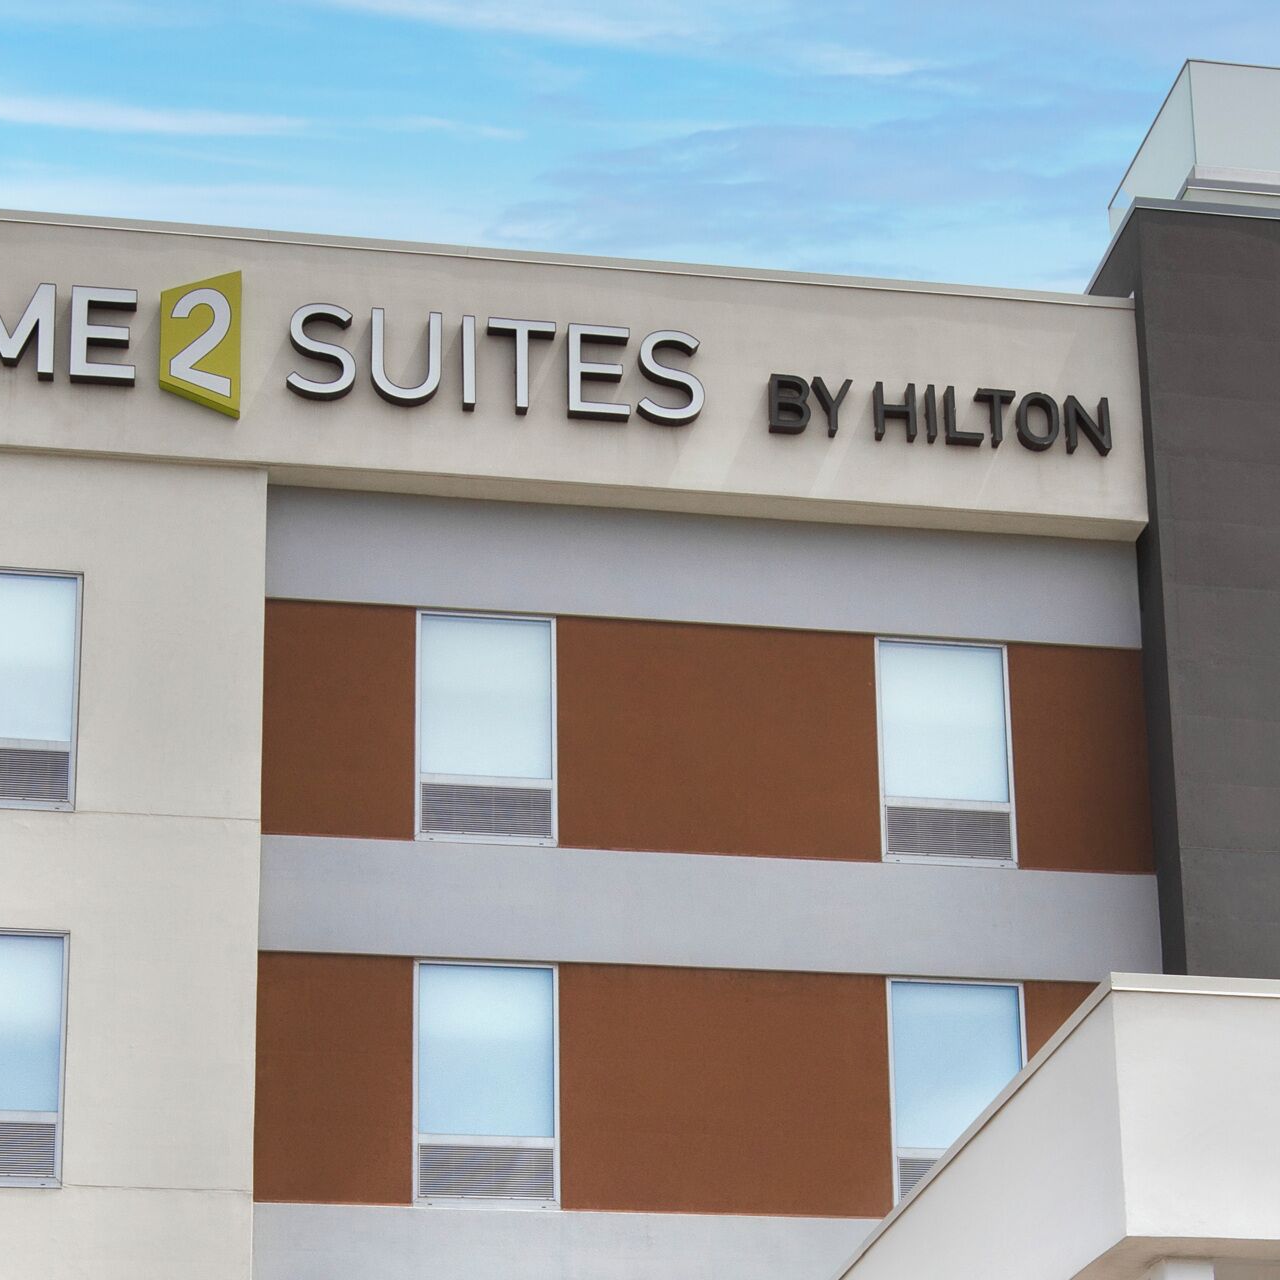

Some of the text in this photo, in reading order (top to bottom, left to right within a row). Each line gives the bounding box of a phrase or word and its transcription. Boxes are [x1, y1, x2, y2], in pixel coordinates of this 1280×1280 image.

[286, 303, 706, 427] SUITES
[768, 373, 853, 438] BY
[871, 380, 1113, 457] HILTON
